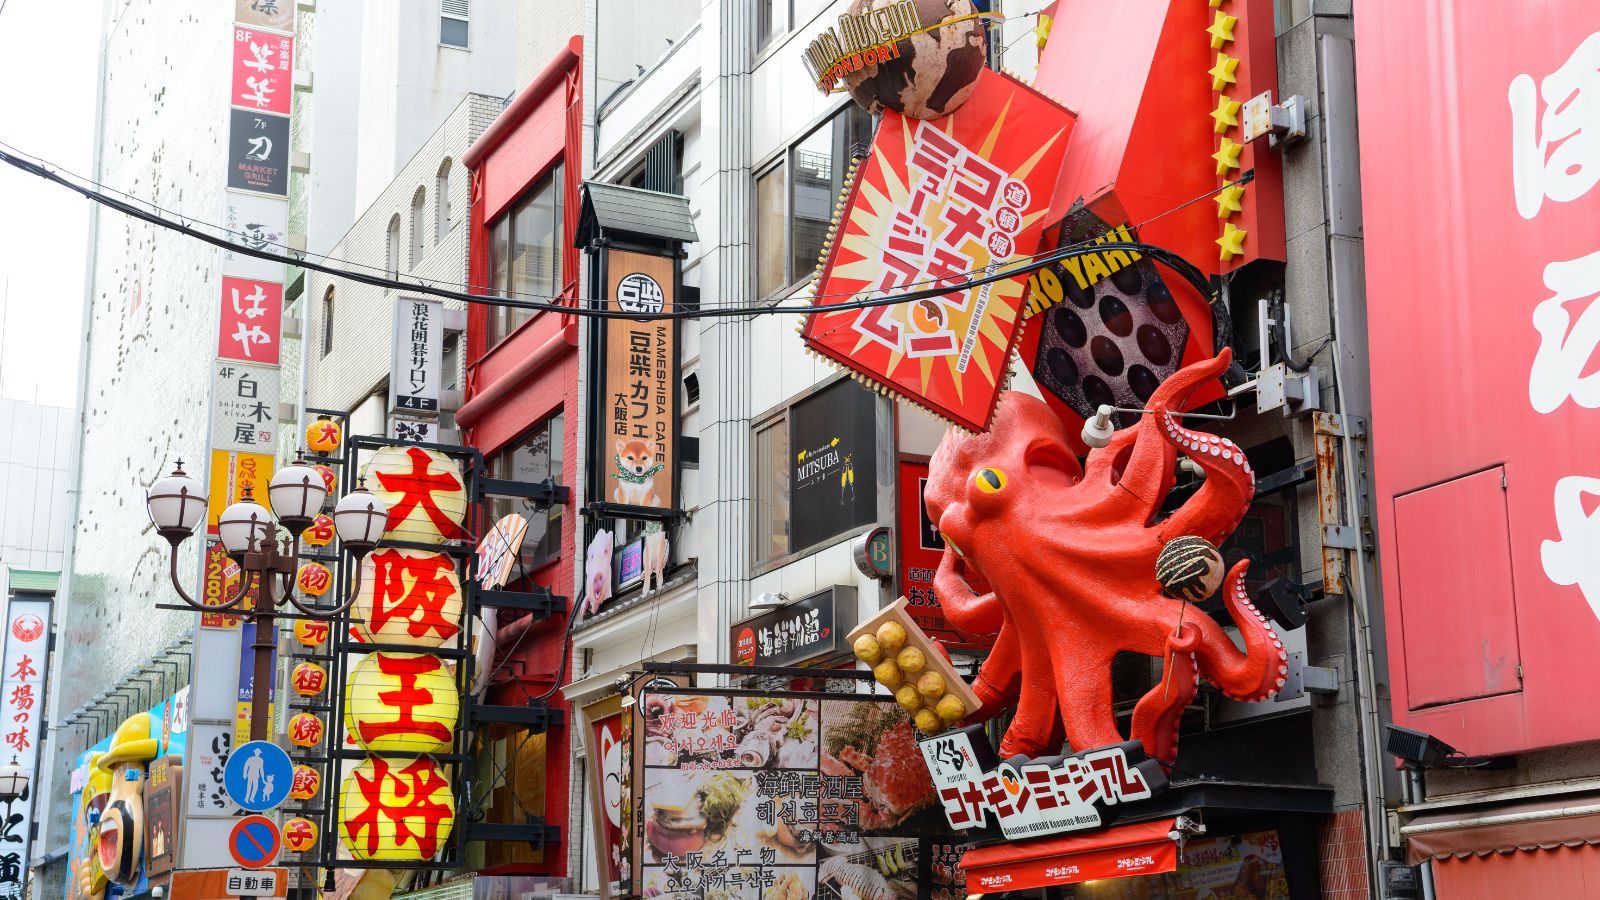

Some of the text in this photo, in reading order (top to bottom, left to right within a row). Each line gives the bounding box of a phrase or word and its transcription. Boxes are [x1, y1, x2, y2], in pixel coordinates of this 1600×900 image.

[235, 29, 253, 43] 8F
[838, 0, 922, 54] MUSEUM
[254, 118, 267, 129] 7F
[238, 162, 279, 176] MARKET
[243, 171, 272, 183] GRILL
[989, 180, 1029, 258] 道頓堀
[1060, 223, 1142, 290] YAKI
[231, 284, 271, 357] はや
[410, 302, 429, 396] 浪花囲碁サロン
[219, 367, 235, 379] 4F
[629, 330, 651, 439] 豆柴カフェ
[233, 373, 272, 445] 白木屋
[655, 326, 667, 462] MAMESHIBA CAFE
[614, 392, 628, 436] 大阪店
[797, 449, 840, 482] MITSUBA
[872, 540, 888, 562] B
[908, 567, 937, 582] 道頓
[344, 447, 474, 859] 大阪王将
[5, 654, 37, 752] 本場の味
[659, 709, 738, 733] 欢迎光临
[663, 734, 738, 757] 어서오세요
[936, 738, 965, 771] くくる
[756, 800, 860, 827] 해선호프집
[661, 847, 777, 872] 大阪名产物
[228, 876, 275, 891] 自動車
